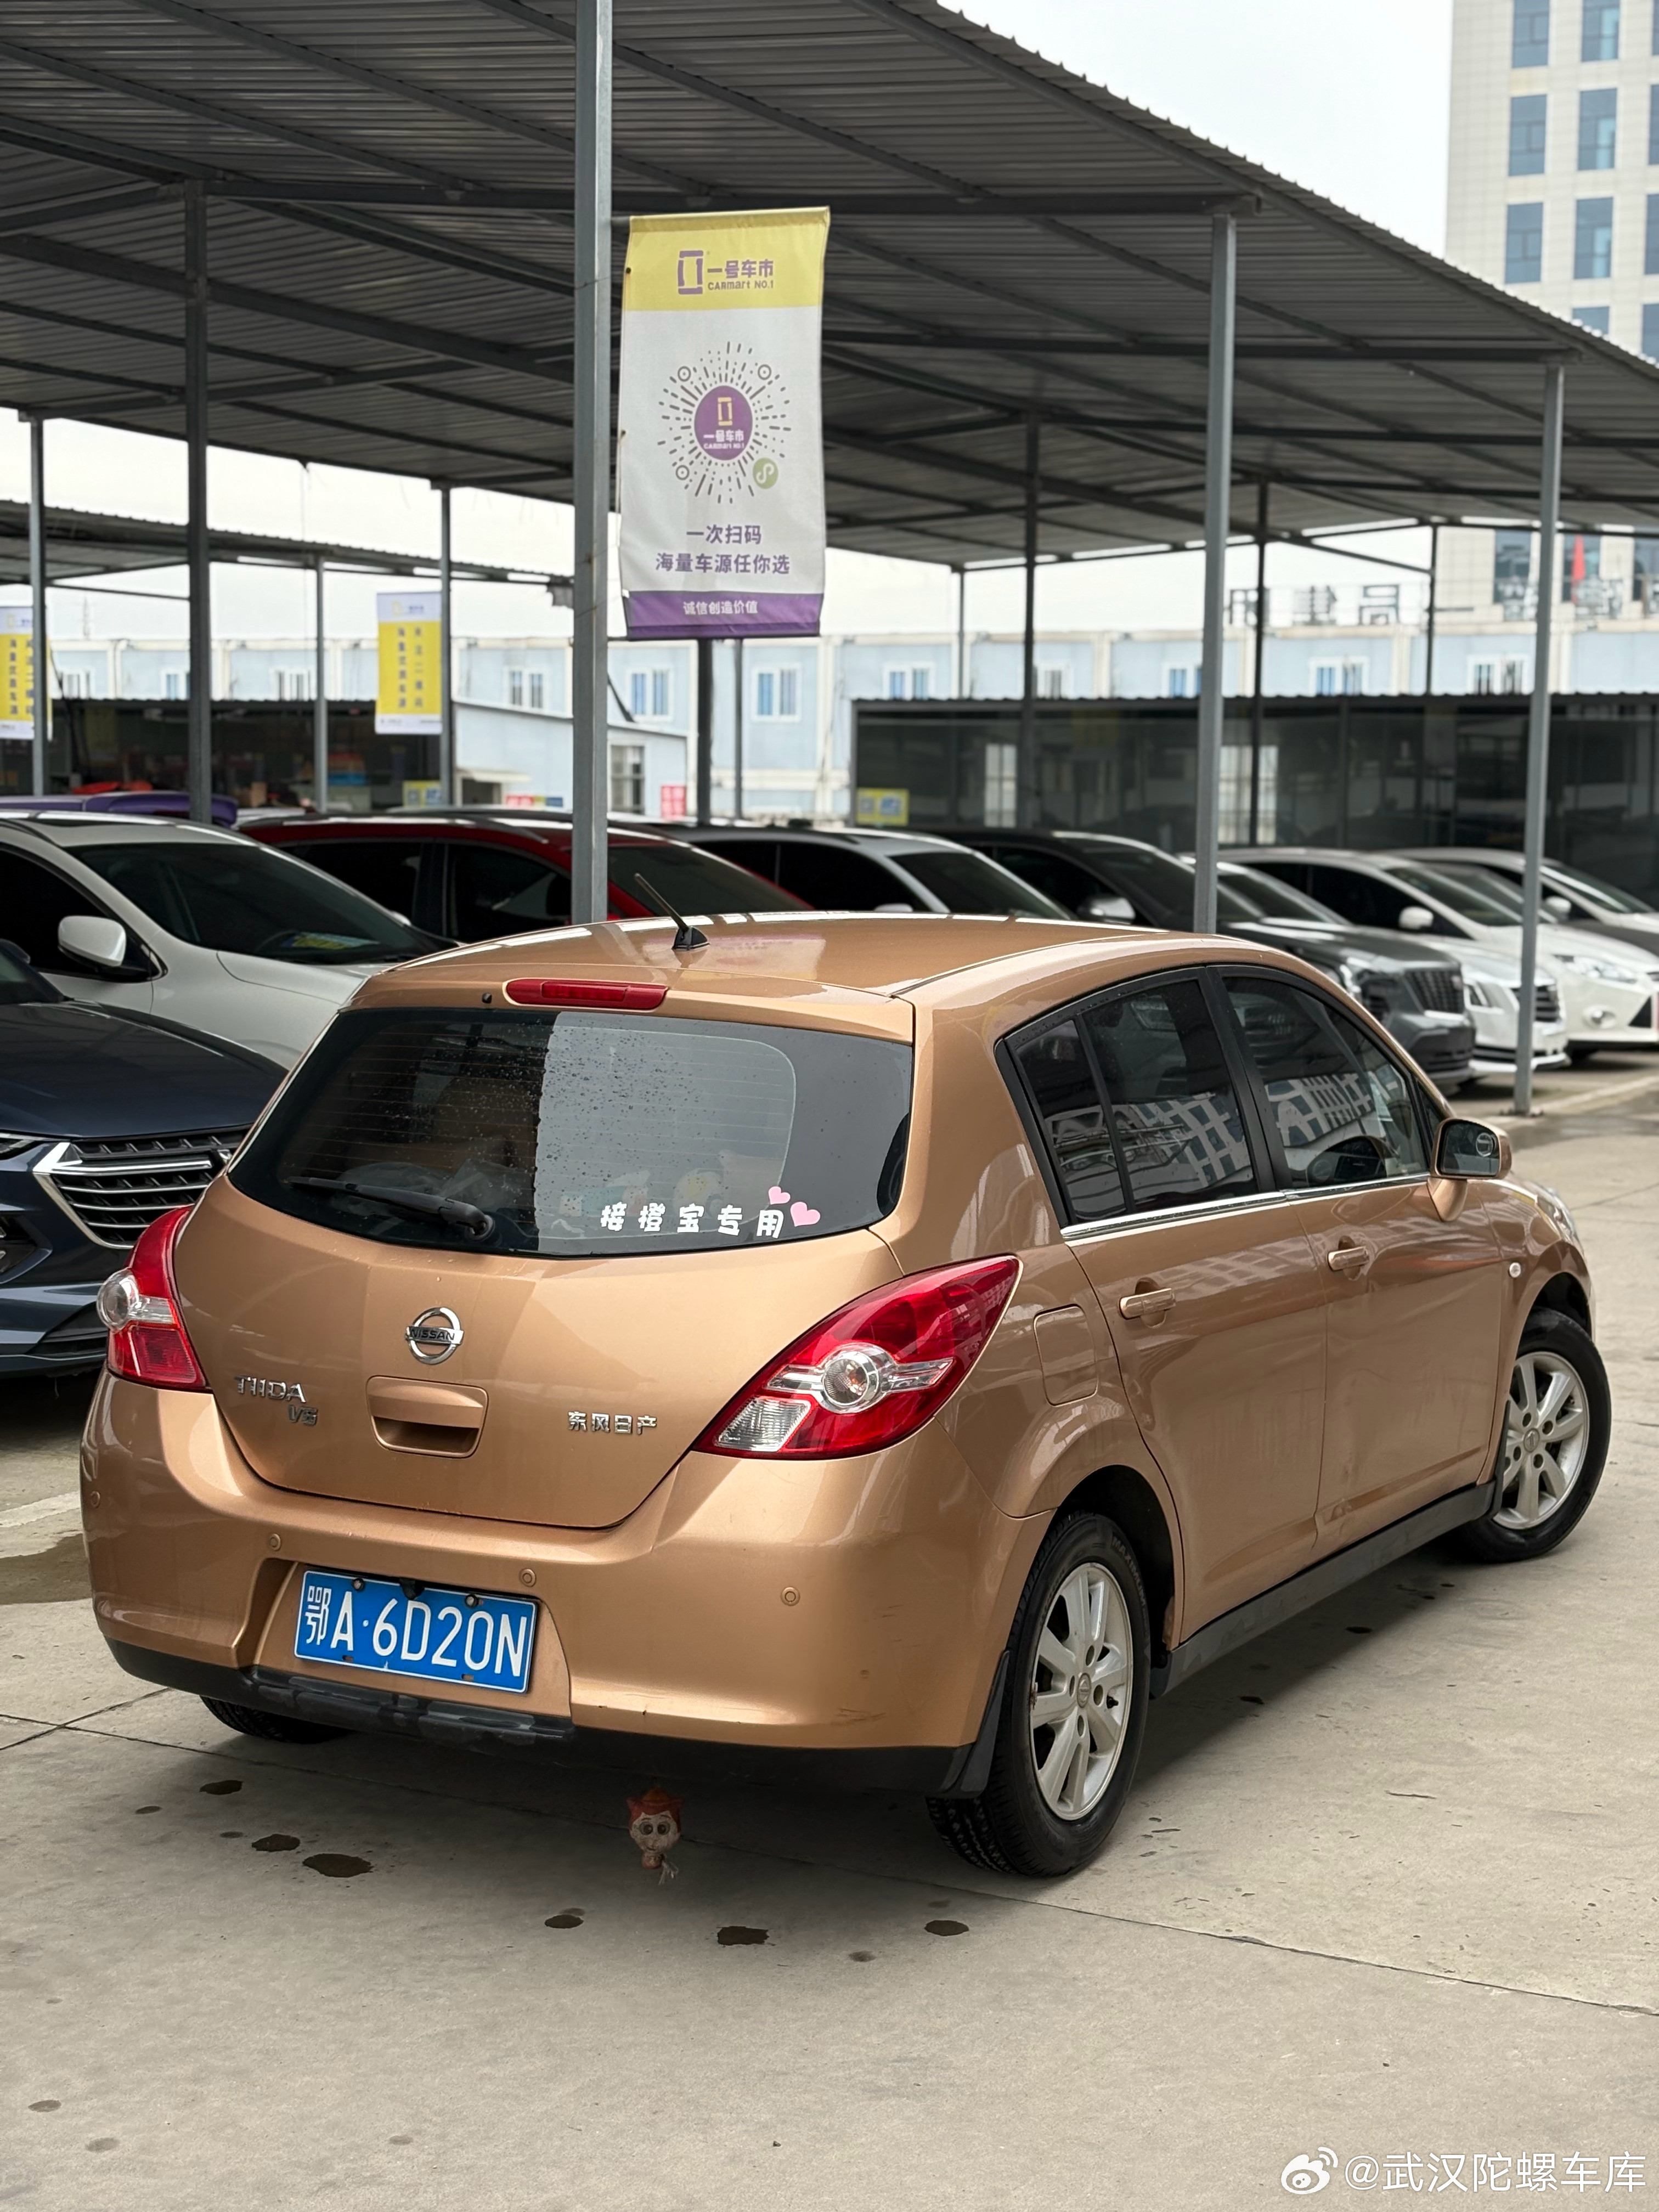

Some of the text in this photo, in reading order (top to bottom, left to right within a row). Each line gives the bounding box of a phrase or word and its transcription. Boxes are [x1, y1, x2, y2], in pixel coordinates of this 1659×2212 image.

[707, 258, 774, 279] 一号车市
[707, 280, 774, 291] CARmart NO.1
[703, 429, 744, 442] 一号车市
[686, 524, 762, 545] 一次扫码
[655, 552, 791, 575] 海量车源任你选
[683, 600, 759, 616] 诚信创造价值
[600, 1201, 785, 1239] 接橙宝专用
[410, 1328, 455, 1341] NISSAN
[233, 1375, 307, 1404] TIIDA
[567, 1411, 658, 1436] 东风日产
[304, 1585, 527, 1678] 鄂A·6D20N
